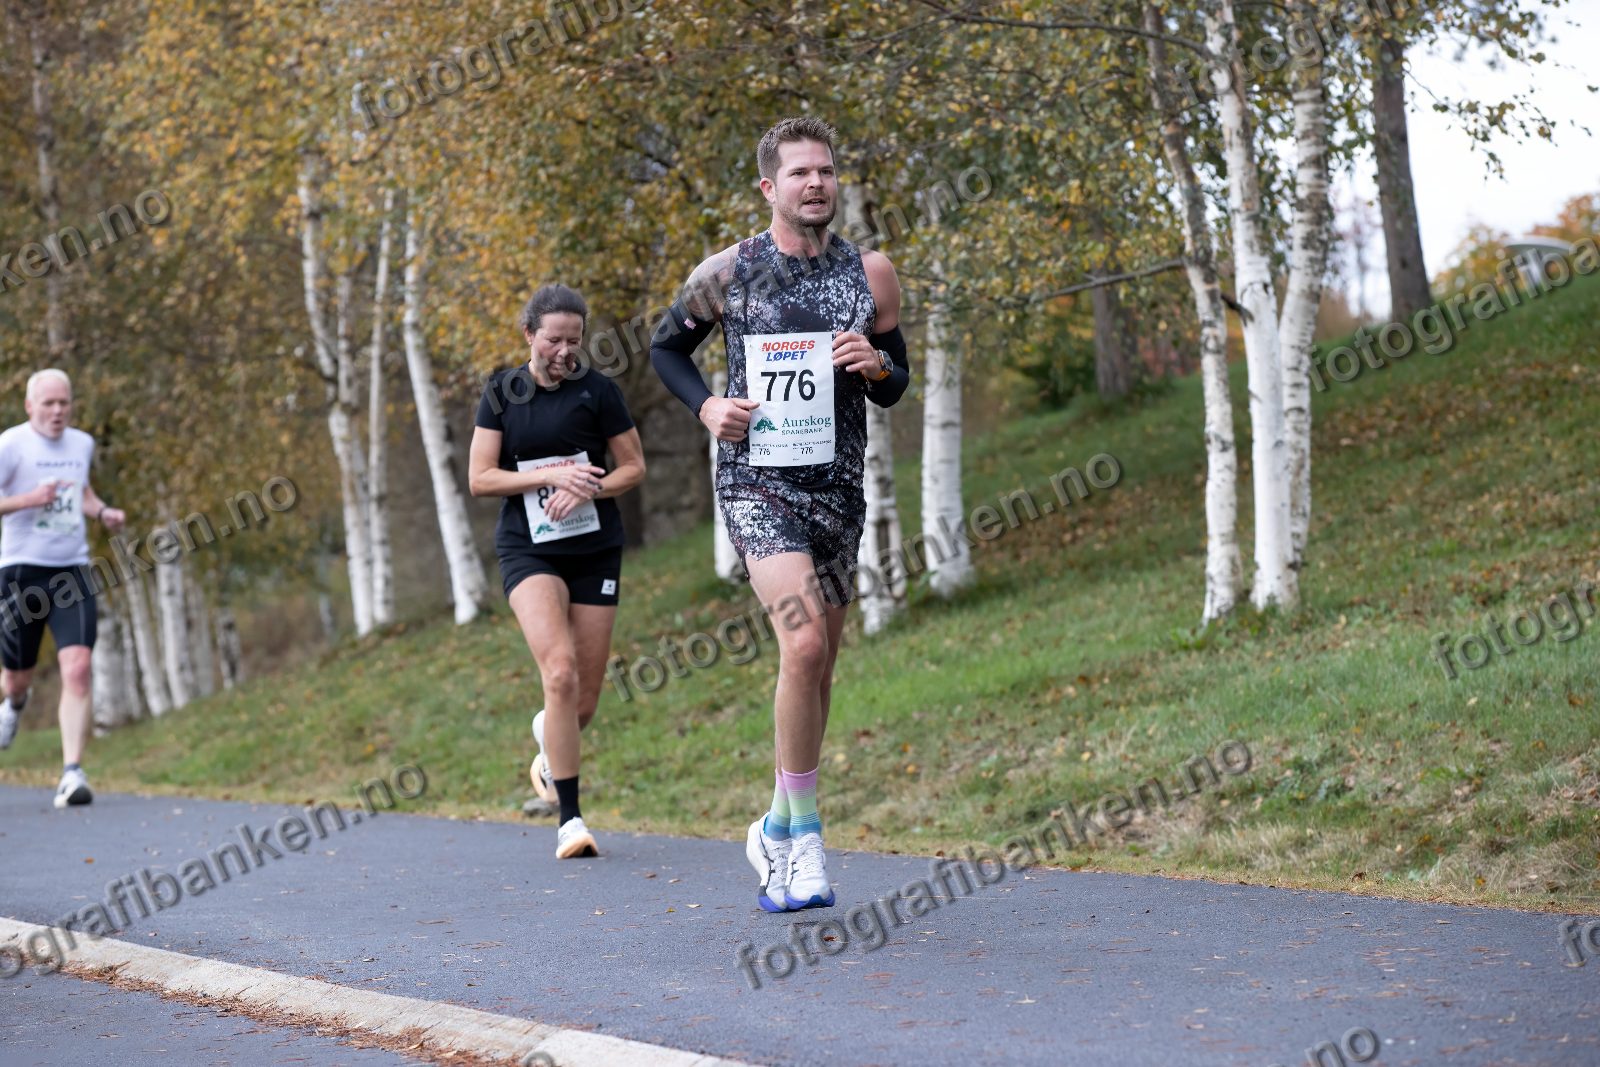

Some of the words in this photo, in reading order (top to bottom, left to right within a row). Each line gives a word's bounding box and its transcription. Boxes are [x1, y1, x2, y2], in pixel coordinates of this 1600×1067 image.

[761, 340, 816, 352] NORGES
[766, 350, 807, 362] LØPET
[761, 369, 816, 401] 776
[781, 415, 832, 427] Aurskog
[781, 428, 823, 436] SPAREBANK
[801, 446, 814, 455] 776
